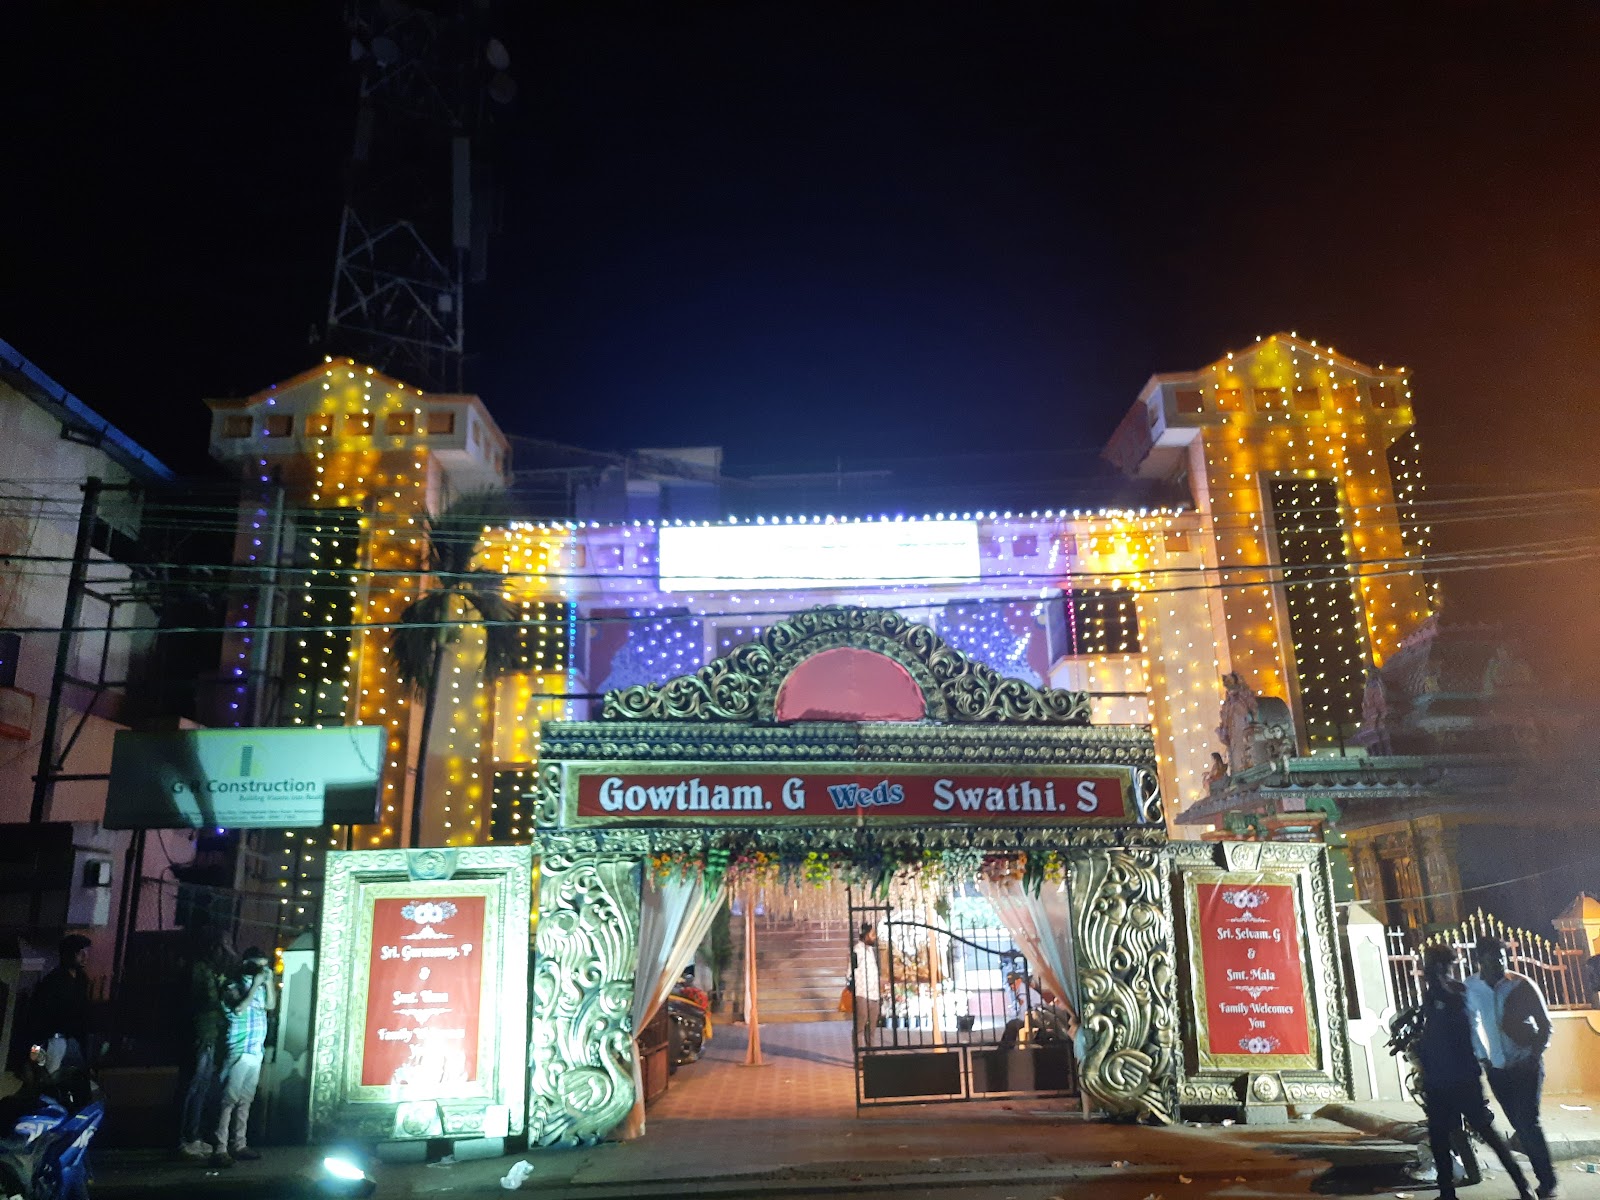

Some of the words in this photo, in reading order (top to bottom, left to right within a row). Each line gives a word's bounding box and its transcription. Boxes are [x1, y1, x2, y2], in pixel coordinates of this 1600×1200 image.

[206, 778, 316, 793] Construction
[599, 776, 773, 811] Gowtham.
[782, 777, 806, 811] G
[827, 780, 904, 809] Weds
[932, 778, 1066, 812] Swathi.
[1076, 780, 1098, 812] S
[1235, 928, 1271, 940] Selvam.
[1273, 928, 1281, 943] G
[1247, 948, 1256, 959] &
[1226, 968, 1249, 982] Smt.
[1249, 966, 1276, 981] Mala
[1219, 1002, 1248, 1016] Family
[1250, 1003, 1294, 1014] Welcomes
[1248, 1018, 1265, 1031] You
